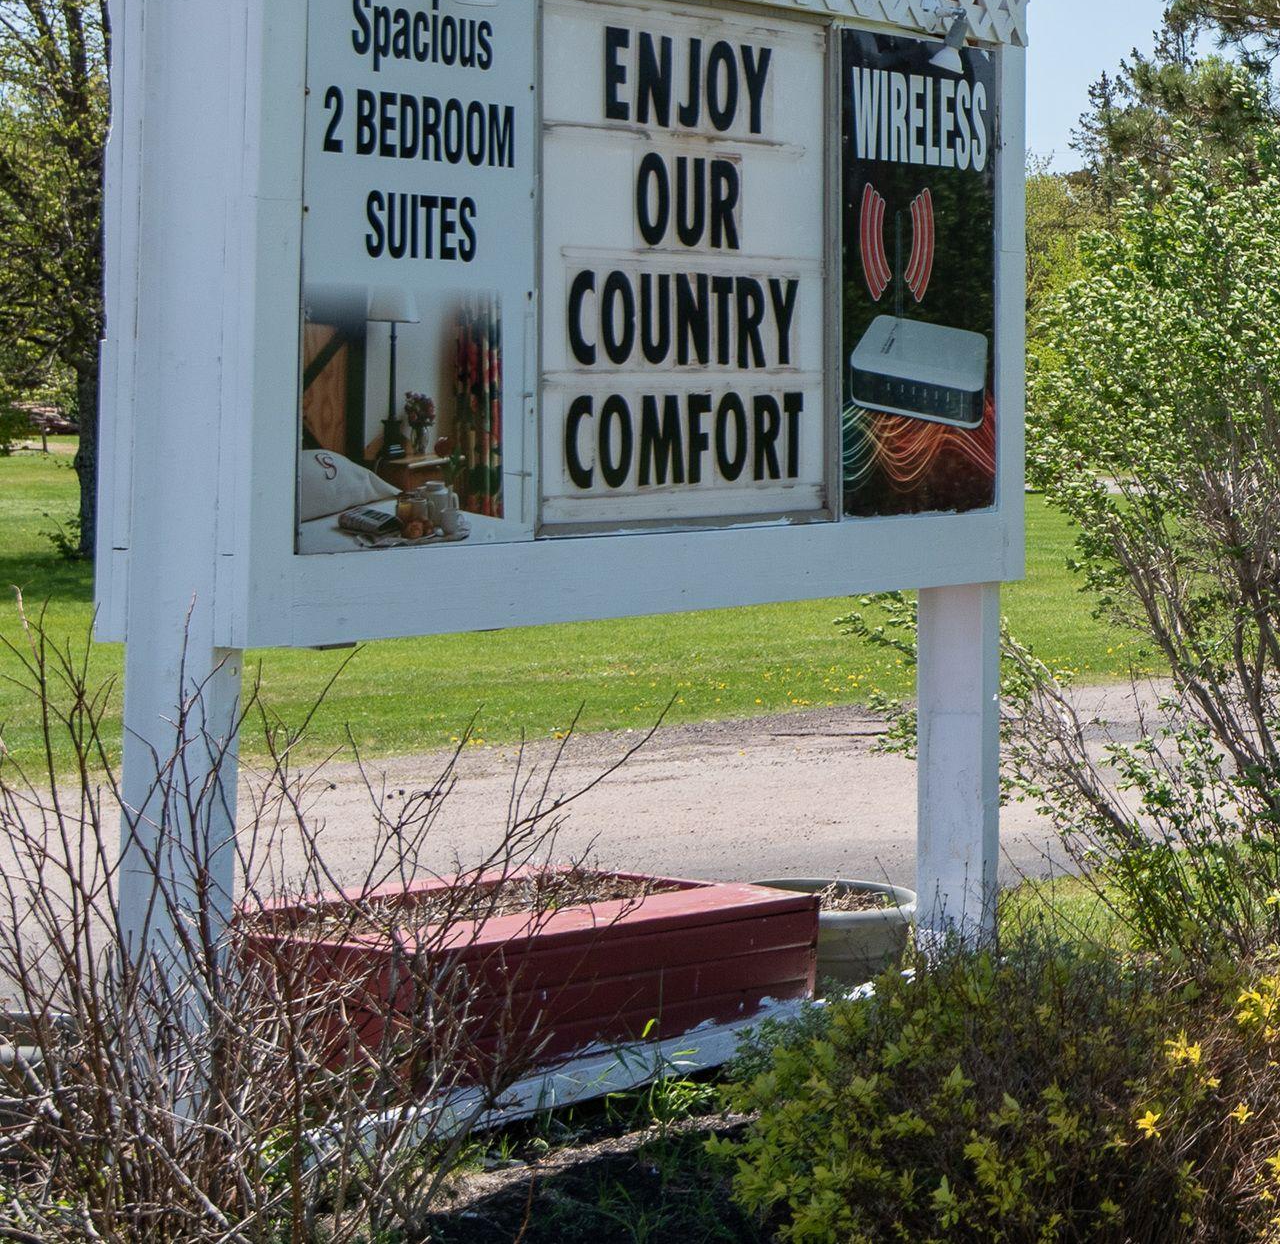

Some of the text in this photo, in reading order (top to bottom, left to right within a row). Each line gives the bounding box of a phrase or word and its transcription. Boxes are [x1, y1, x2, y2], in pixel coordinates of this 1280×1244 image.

[323, 85, 515, 168] 2 BEDROOM
[605, 26, 772, 134] ENJOY
[852, 66, 987, 172] WIRELESS
[366, 190, 477, 262] SUITES
[636, 153, 740, 250] OUR
[568, 270, 799, 369] COUNTRY
[565, 392, 804, 489] COMFORT
